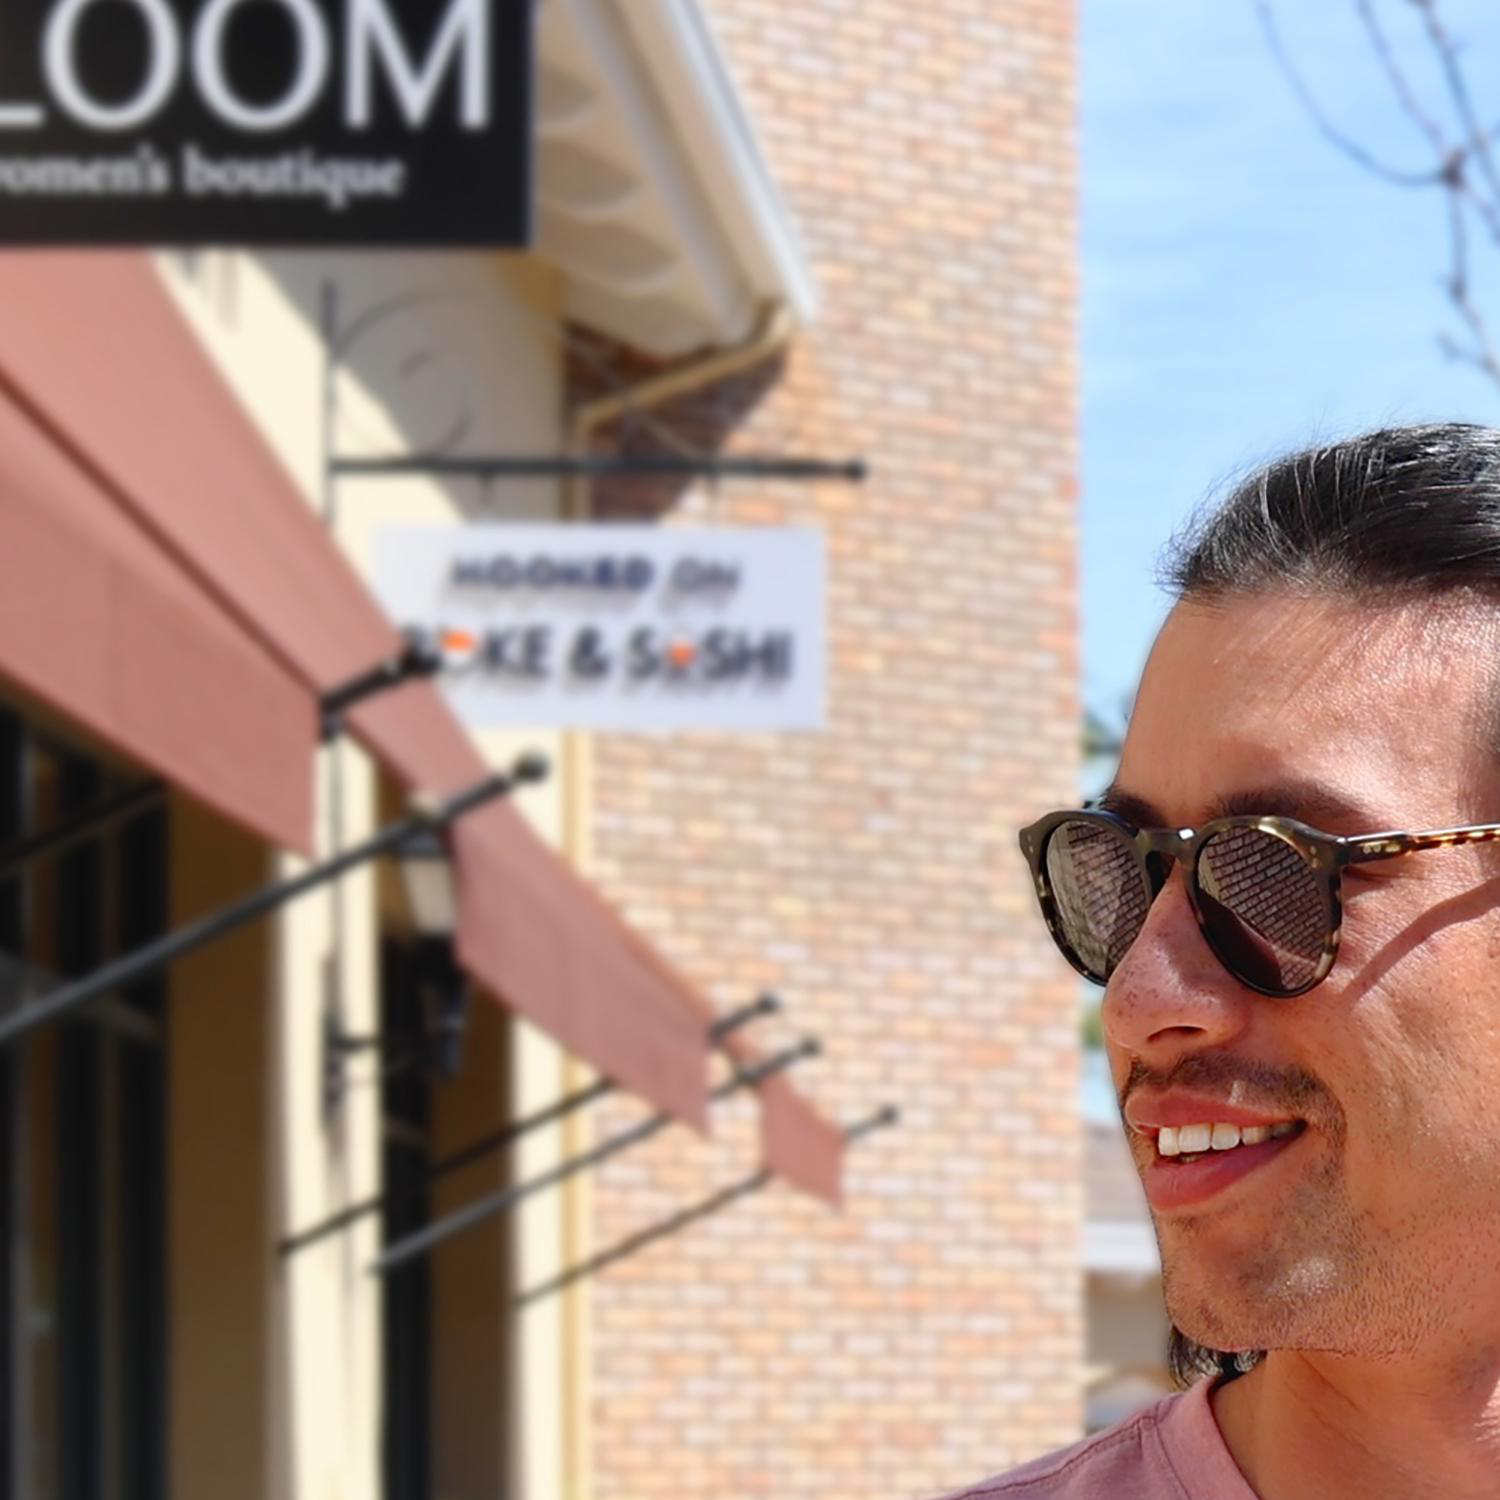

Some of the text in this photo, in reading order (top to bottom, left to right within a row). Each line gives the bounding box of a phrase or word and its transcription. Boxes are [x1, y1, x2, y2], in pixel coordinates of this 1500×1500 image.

[0, 143, 403, 209] omen's boutique
[571, 625, 610, 682] &
